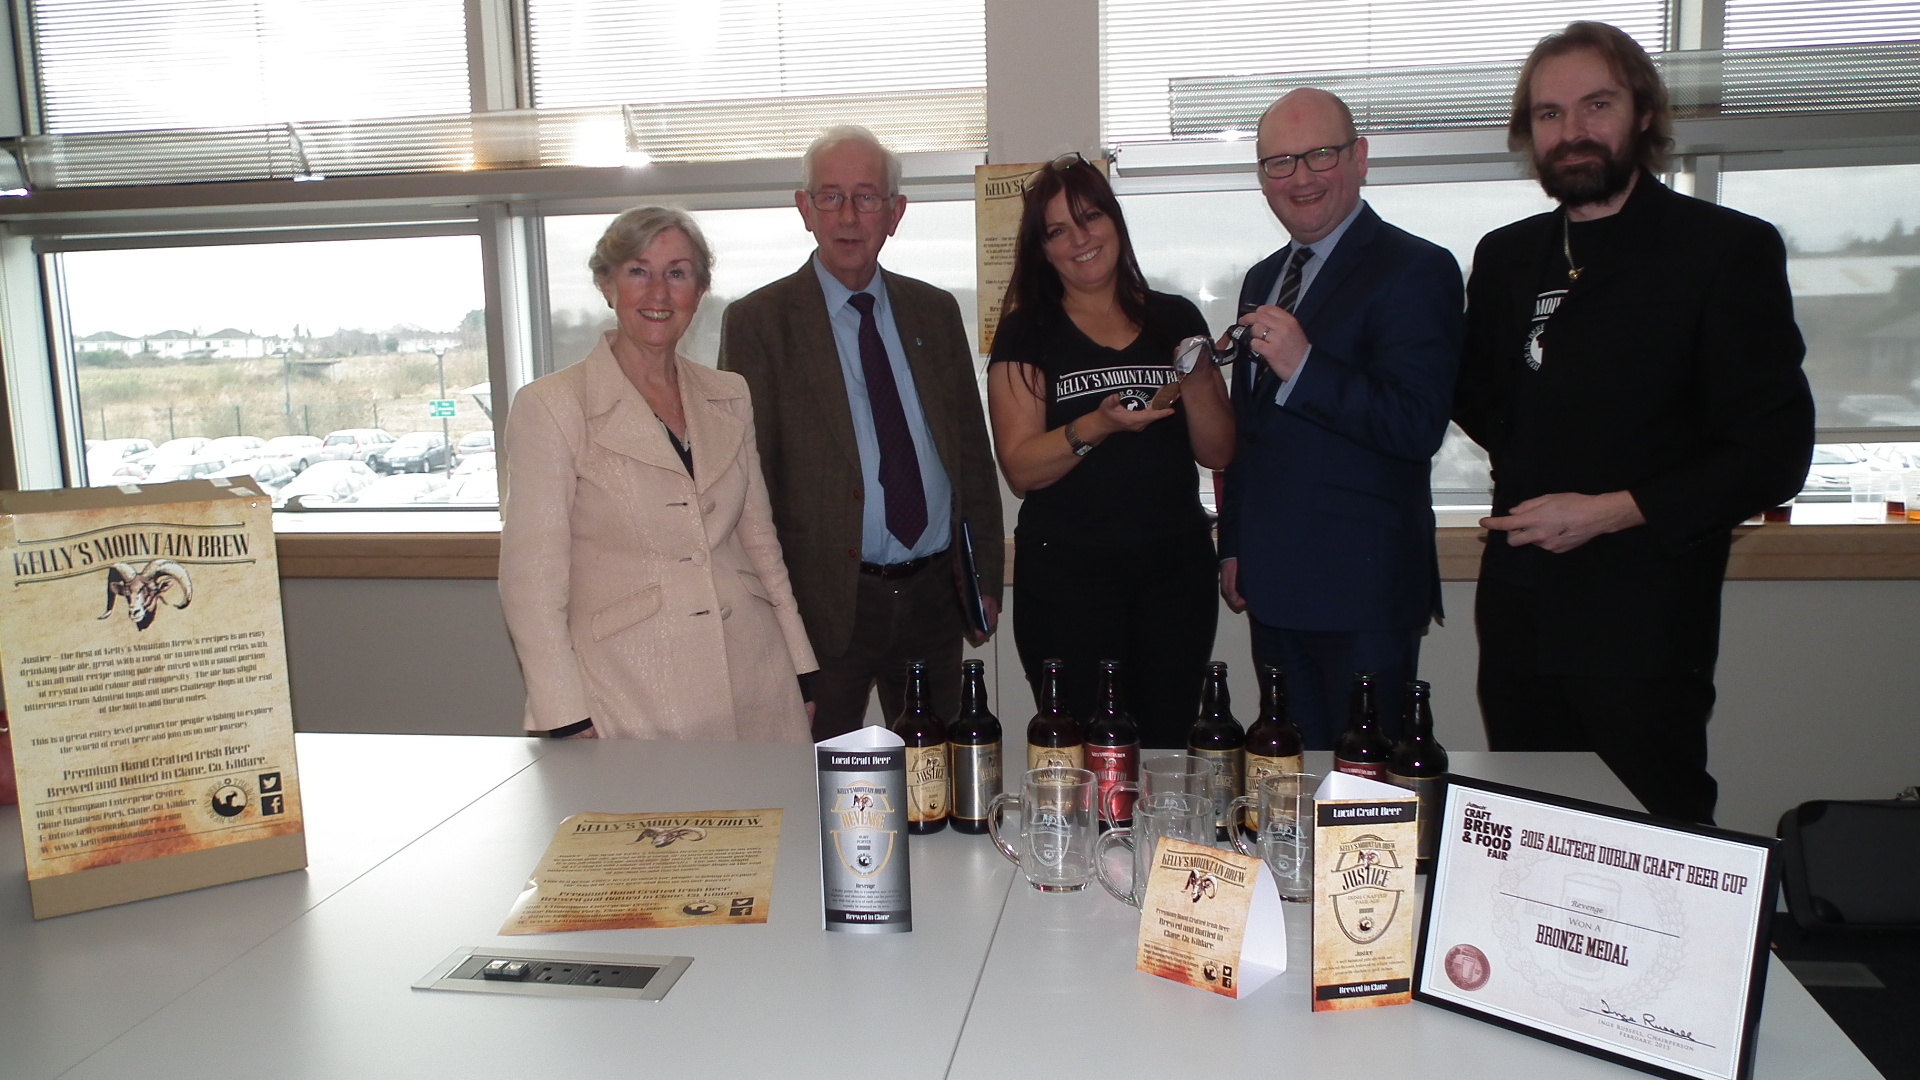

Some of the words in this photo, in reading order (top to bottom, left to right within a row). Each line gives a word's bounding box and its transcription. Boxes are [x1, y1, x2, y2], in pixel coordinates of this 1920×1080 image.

[985, 180, 1020, 196] KELLY'S
[1056, 373, 1102, 397] KELLY'S
[1101, 370, 1164, 388] MOUNTAIN
[13, 542, 94, 576] KELLY'S
[94, 533, 194, 561] MOUNTAIN
[198, 533, 250, 558] BREW
[63, 765, 119, 780] Premium
[121, 758, 149, 772] Hand
[152, 752, 193, 767] Crafted
[196, 747, 222, 760] Irish
[224, 744, 250, 756] Beer
[832, 755, 850, 765] Local
[852, 756, 871, 765] Craft
[872, 756, 891, 765] Beer
[47, 781, 93, 798] Brewed
[96, 778, 117, 790] and
[120, 771, 158, 787] Bottled
[161, 769, 172, 781] in
[841, 810, 885, 828] REVENGE
[1333, 808, 1355, 818] Local
[1356, 807, 1379, 817] Craft
[1380, 806, 1402, 816] Beer
[1464, 808, 1492, 821] CRAFT
[575, 822, 635, 833] KELLY'S
[639, 818, 716, 828] MOUNTAIN
[717, 818, 762, 827] BREW
[1463, 817, 1512, 839] BREWS
[1462, 830, 1473, 844] &
[1475, 833, 1512, 851] FOOD
[1487, 848, 1508, 861] FAIR
[1520, 829, 1545, 850] 2015
[1546, 835, 1597, 862] ALLTECH
[1599, 845, 1642, 872] DUBLIN
[1643, 855, 1685, 881] CRAFT
[1686, 864, 1719, 890] BEER
[1722, 873, 1748, 895] CUP
[1162, 853, 1189, 867] KELLY'S
[1190, 856, 1224, 876] MOUNTAIN
[1224, 866, 1246, 883] BREW
[1342, 867, 1391, 890] JUSTICE
[1571, 900, 1604, 914] Revenge
[1159, 917, 1182, 931] Brewed
[1183, 924, 1194, 934] and
[1194, 927, 1216, 940] Bottled
[1217, 933, 1224, 941] in
[1594, 924, 1602, 933] A
[1535, 923, 1584, 955] BRONZE
[1584, 936, 1629, 967] MEDAL
